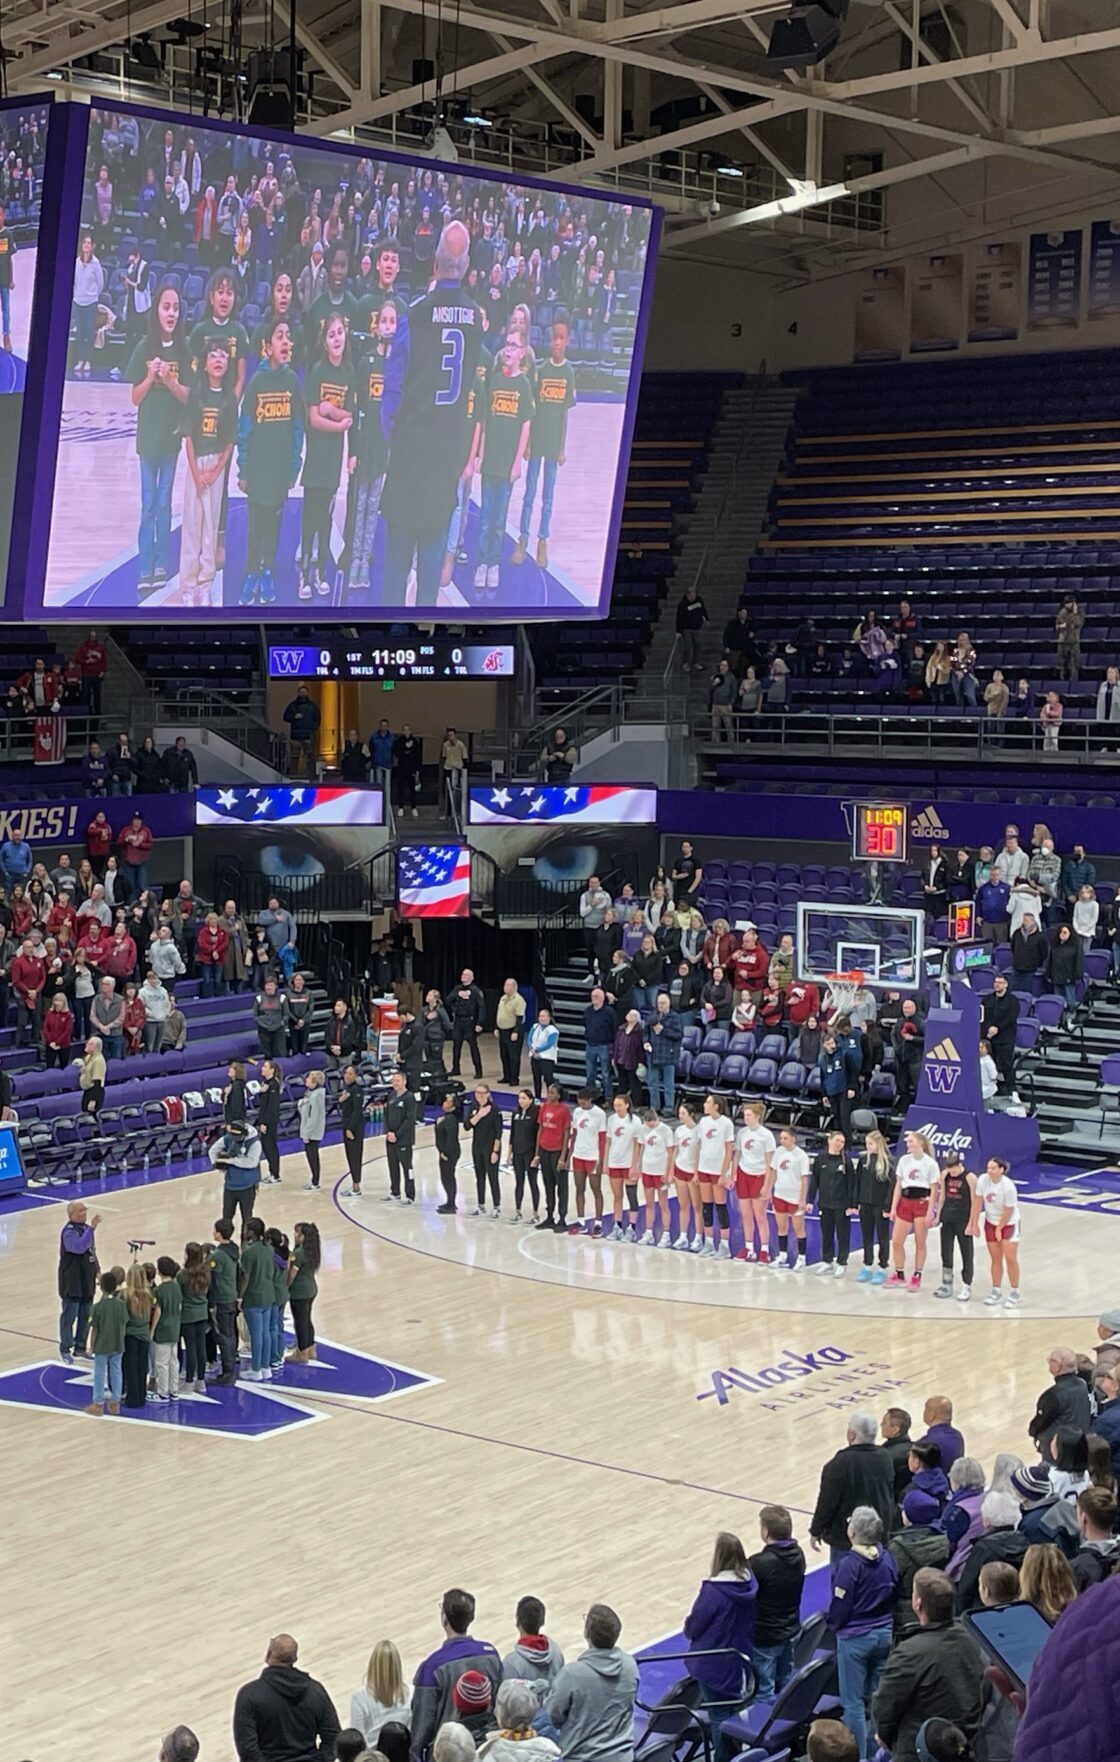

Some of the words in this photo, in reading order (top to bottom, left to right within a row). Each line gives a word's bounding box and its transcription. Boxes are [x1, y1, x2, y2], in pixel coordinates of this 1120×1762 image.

[730, 323, 742, 337] 3
[788, 321, 798, 336] 4
[435, 328, 465, 405] 3
[274, 651, 304, 673] W
[320, 651, 330, 665] 0
[372, 650, 416, 665] 11:09
[452, 649, 462, 664] 0
[865, 809, 902, 826] 11:09
[867, 826, 897, 855] 30
[925, 1064, 961, 1093] W
[696, 1346, 854, 1406] Alaska
[760, 1362, 892, 1411] AIRLINES
[826, 1378, 909, 1410] ARENA
